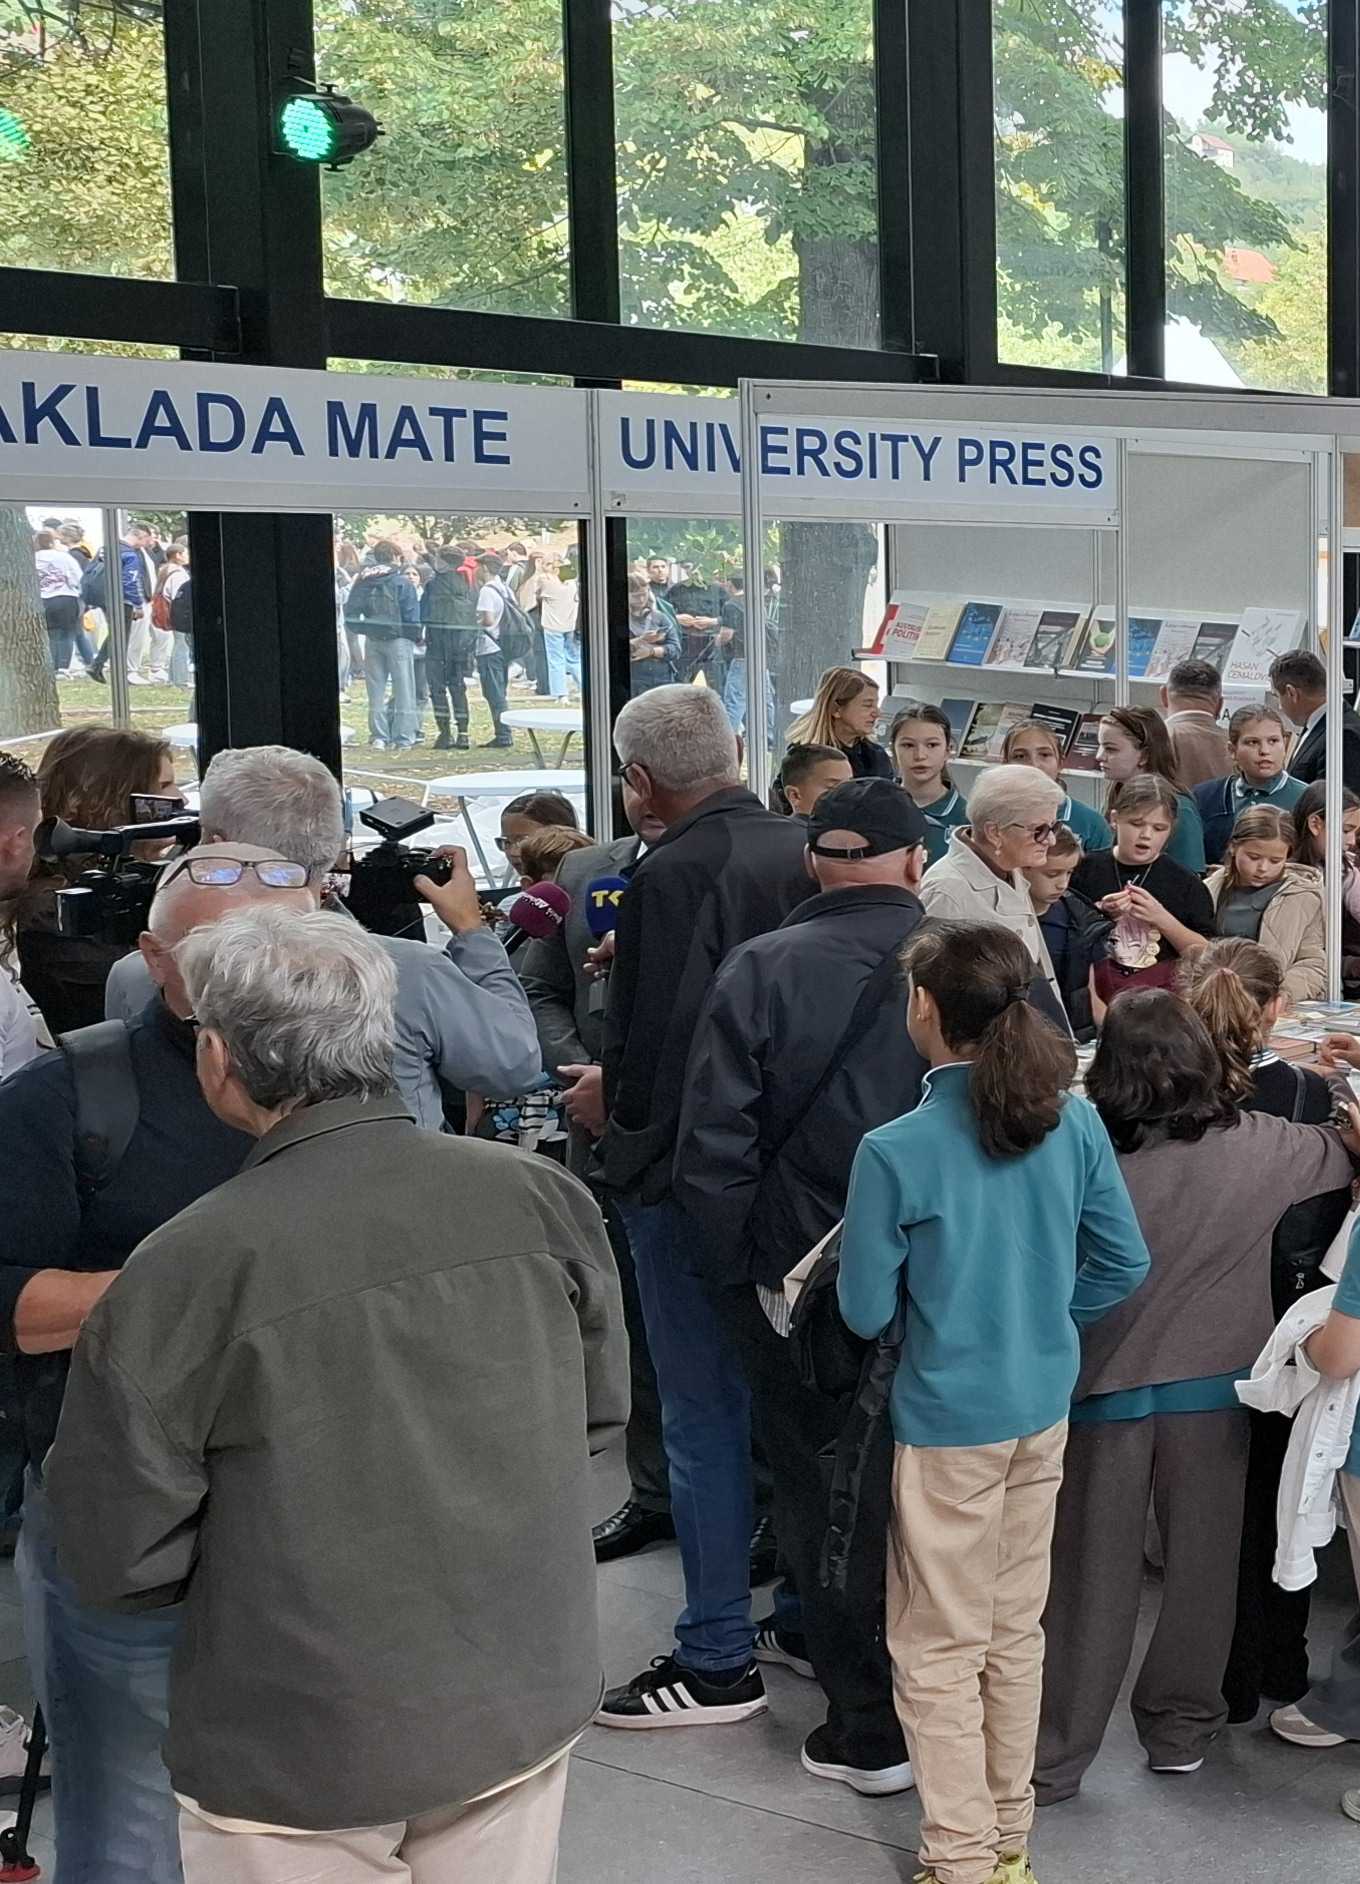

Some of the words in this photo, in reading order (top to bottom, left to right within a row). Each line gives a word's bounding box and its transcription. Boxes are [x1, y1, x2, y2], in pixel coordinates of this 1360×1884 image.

[326, 400, 511, 465] MATE
[619, 416, 943, 482] UNIVERSITY
[957, 437, 1104, 490] PRESS
